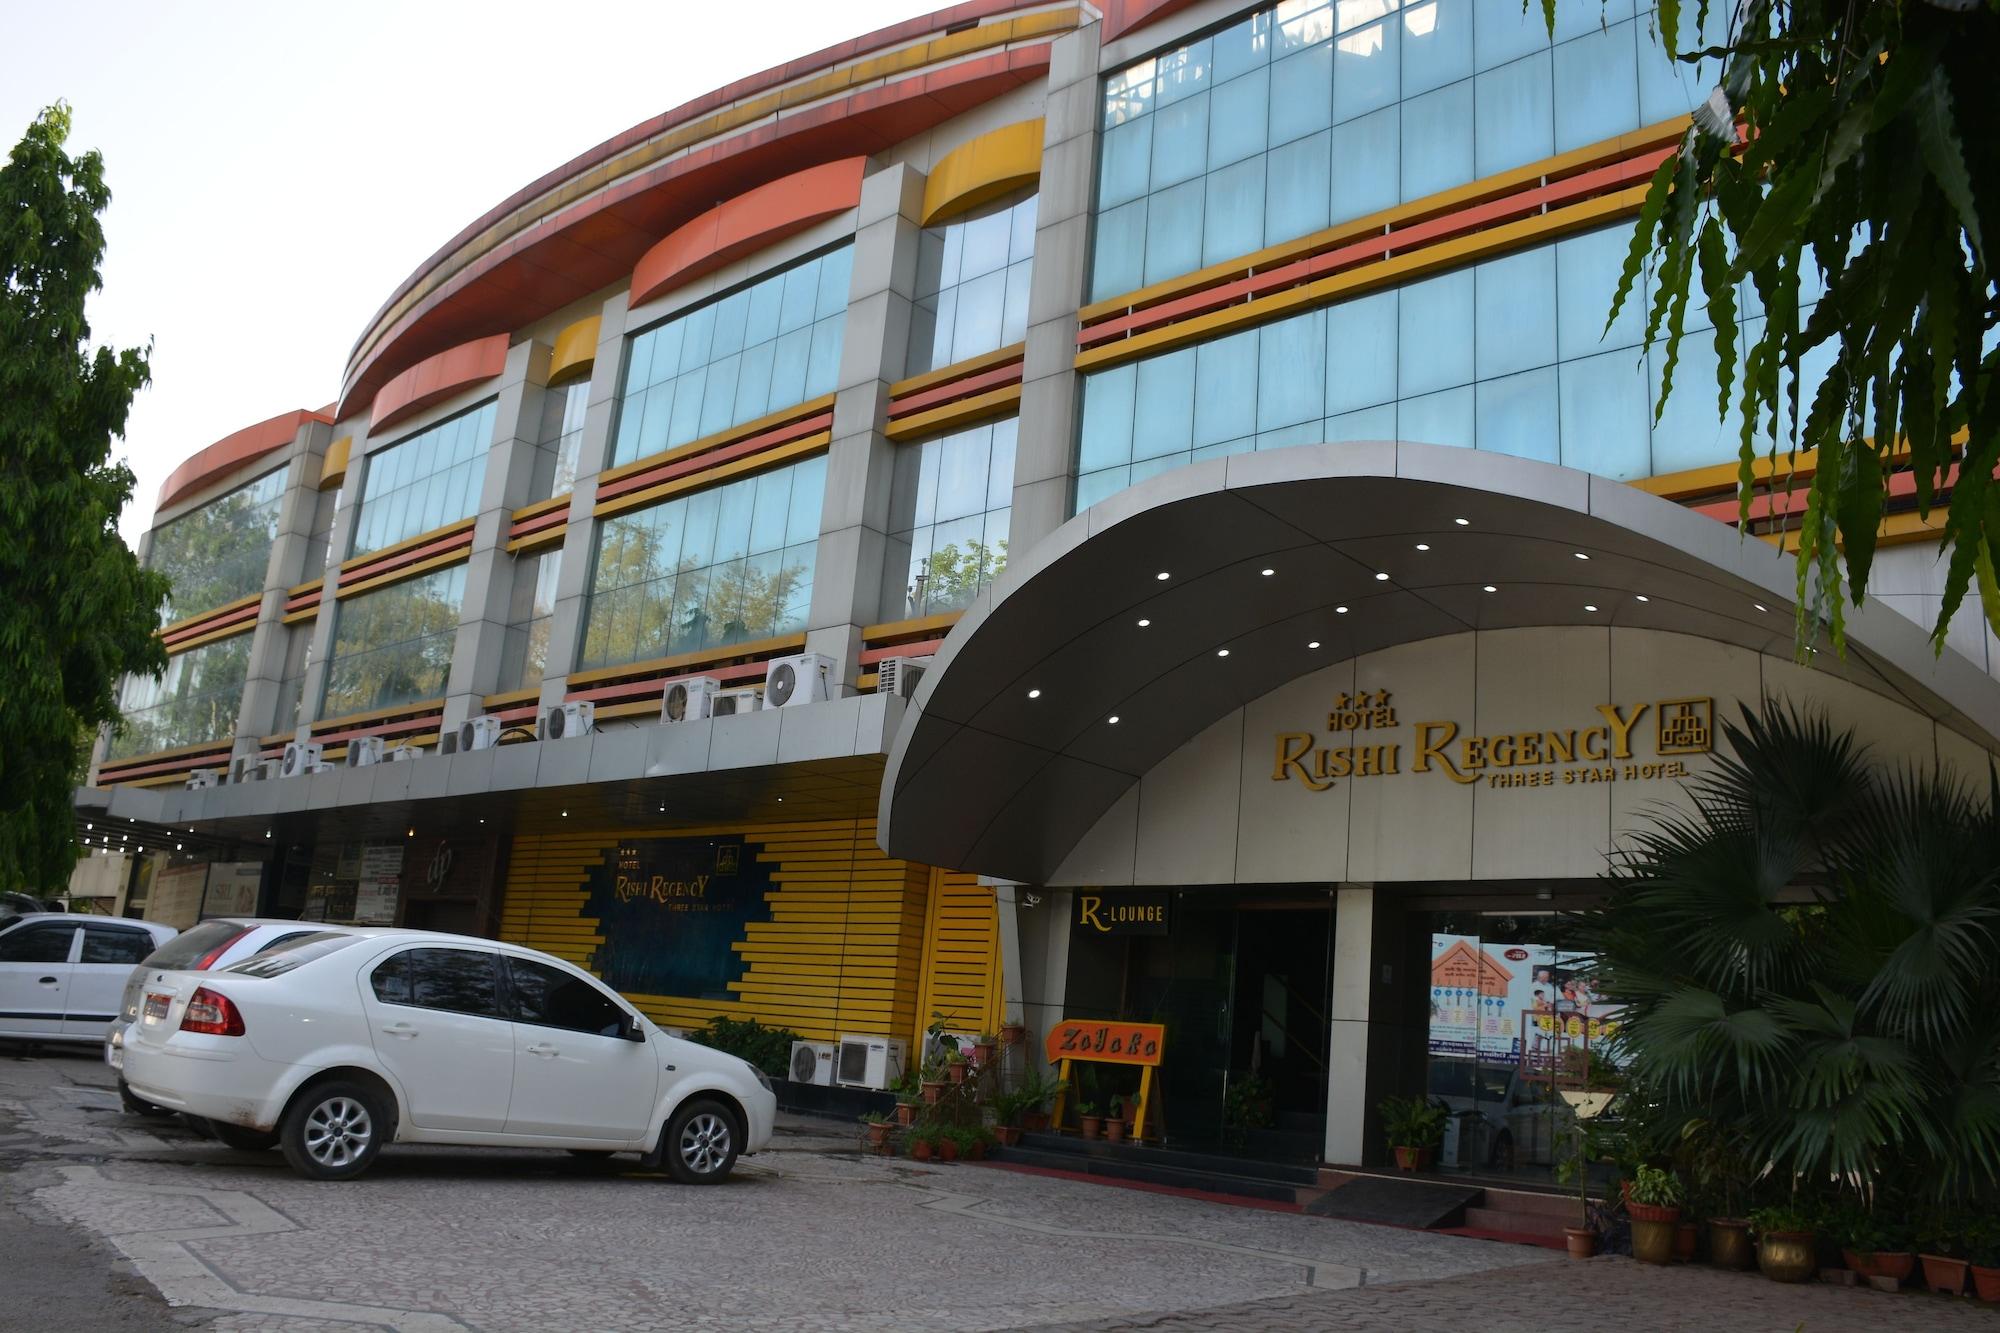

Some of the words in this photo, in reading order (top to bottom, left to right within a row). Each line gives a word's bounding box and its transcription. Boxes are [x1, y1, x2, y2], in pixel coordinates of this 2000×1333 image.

[1328, 708, 1398, 731] HOTEL
[1272, 731, 1400, 791] RISHI
[1411, 703, 1650, 784] REGENCY
[1488, 771, 1553, 788] THREE
[1564, 767, 1615, 784] STAR
[1625, 761, 1690, 779] HOTEL
[619, 860, 640, 870] HOTEL
[615, 875, 647, 903] RISHI
[650, 875, 709, 903] REGENCY
[668, 903, 689, 912] THREE
